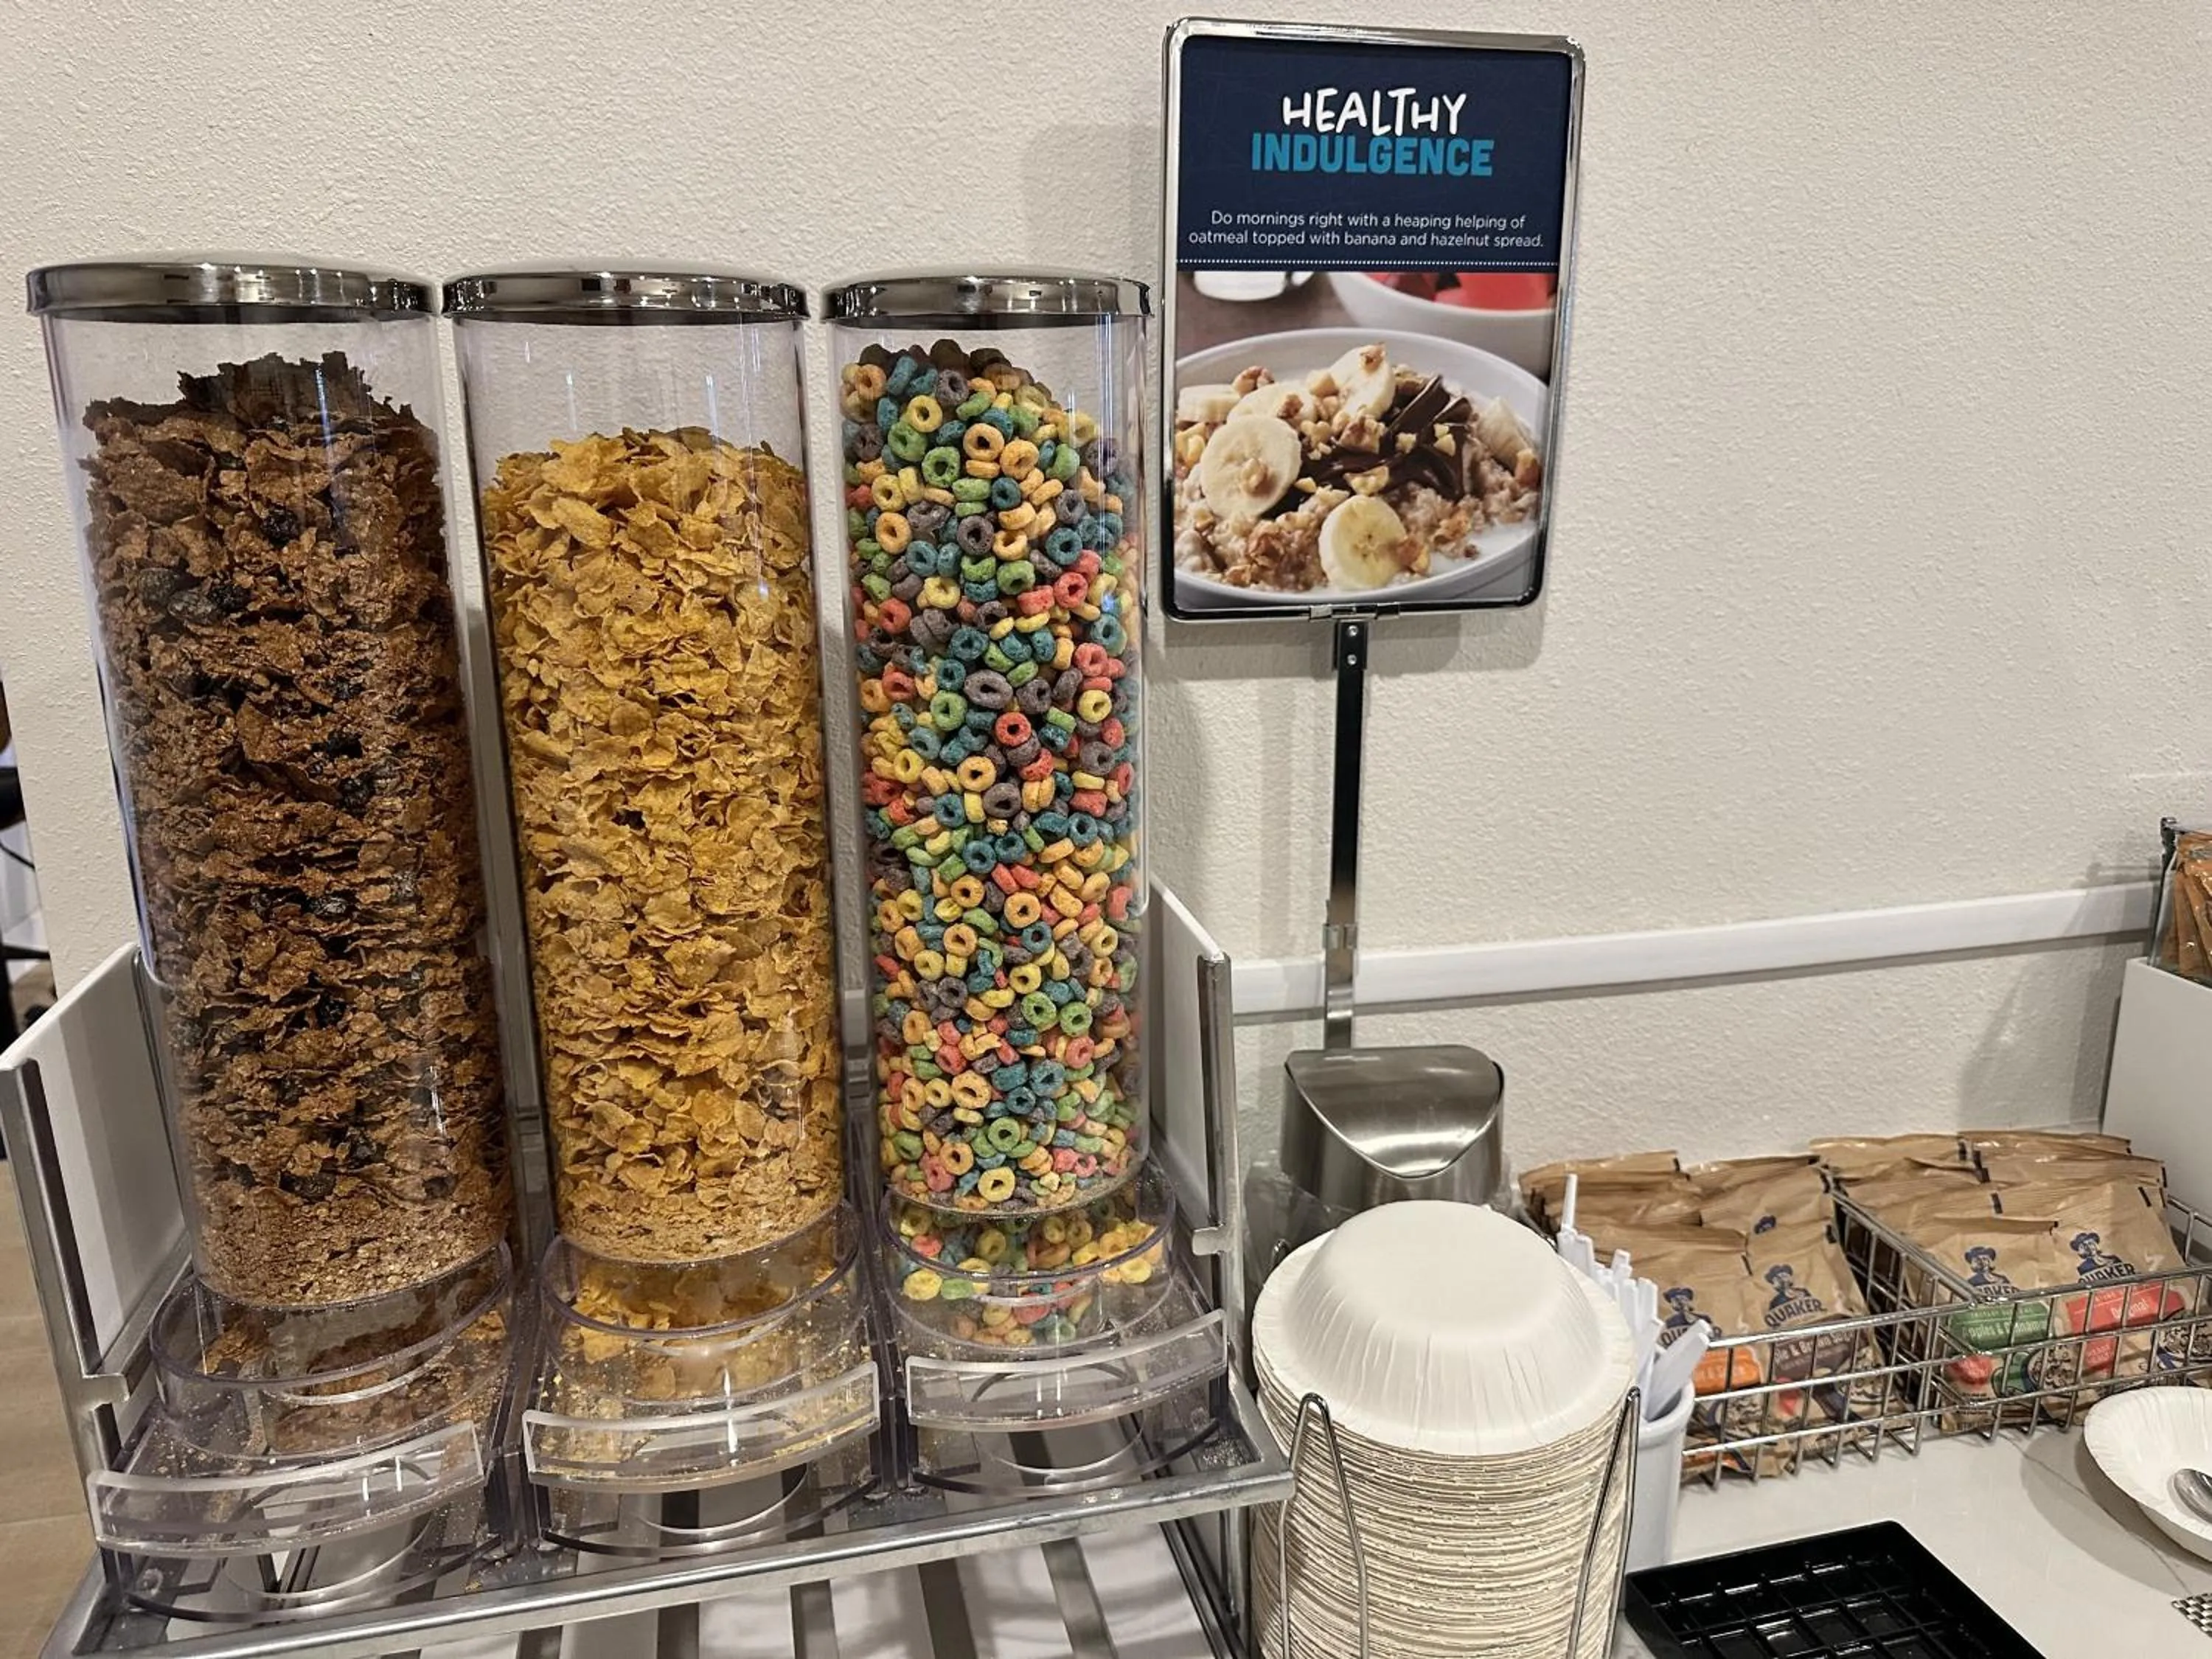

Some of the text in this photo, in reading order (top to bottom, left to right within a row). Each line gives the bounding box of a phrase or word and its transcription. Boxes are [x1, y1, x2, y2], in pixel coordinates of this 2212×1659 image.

[1282, 87, 1467, 136] HEALTHY
[1251, 133, 1495, 176] INDULGENCE
[1211, 209, 1526, 231] Do mornings right with a heaping helping of
[1189, 229, 1544, 248] oatmeal topped with banana and hazelnut spread.
[1764, 1298, 1823, 1326] QUAKER
